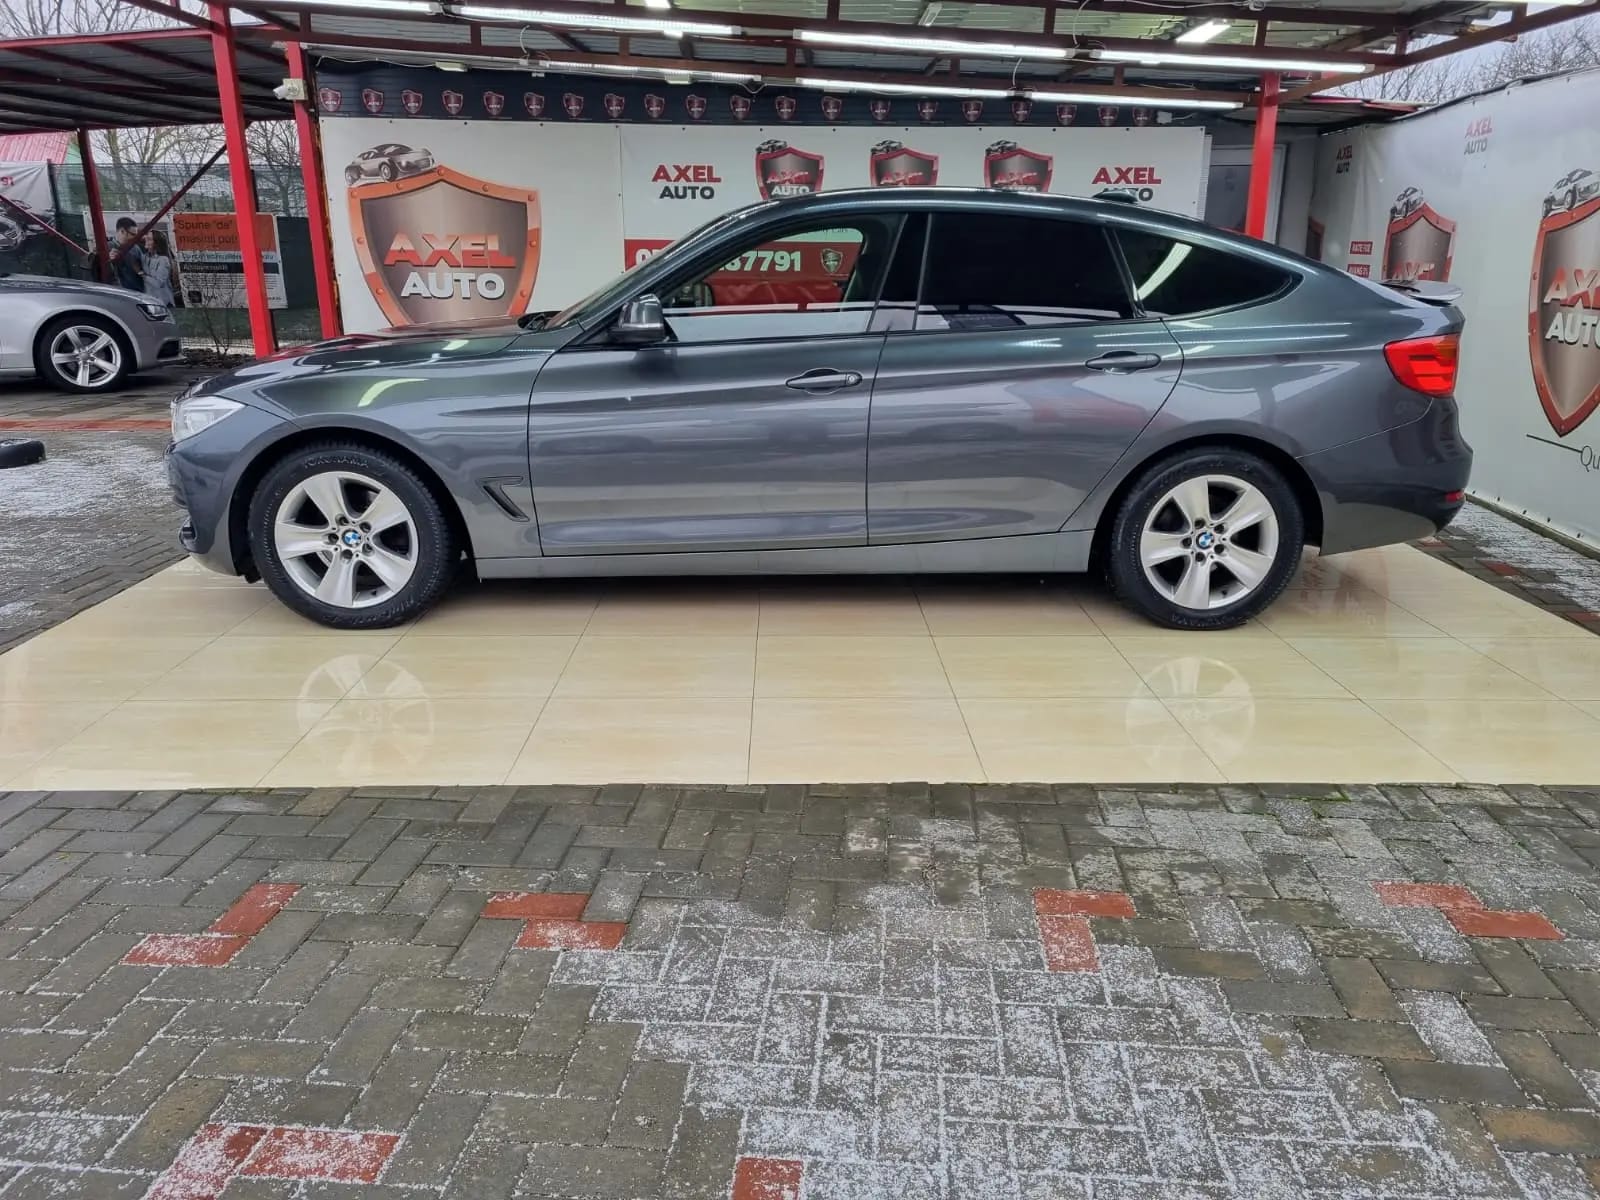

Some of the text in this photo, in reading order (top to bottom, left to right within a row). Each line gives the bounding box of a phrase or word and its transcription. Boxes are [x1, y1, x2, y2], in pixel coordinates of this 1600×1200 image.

[1464, 116, 1493, 138] AXEL
[1463, 138, 1488, 155] AUTO
[652, 165, 722, 183] AXEL
[1091, 166, 1162, 185] AXEL
[659, 186, 715, 200] AUTO
[384, 233, 517, 269] AXEL
[718, 250, 801, 272] 87791
[401, 271, 506, 300] AUTO
[1545, 312, 1600, 350] AUT
